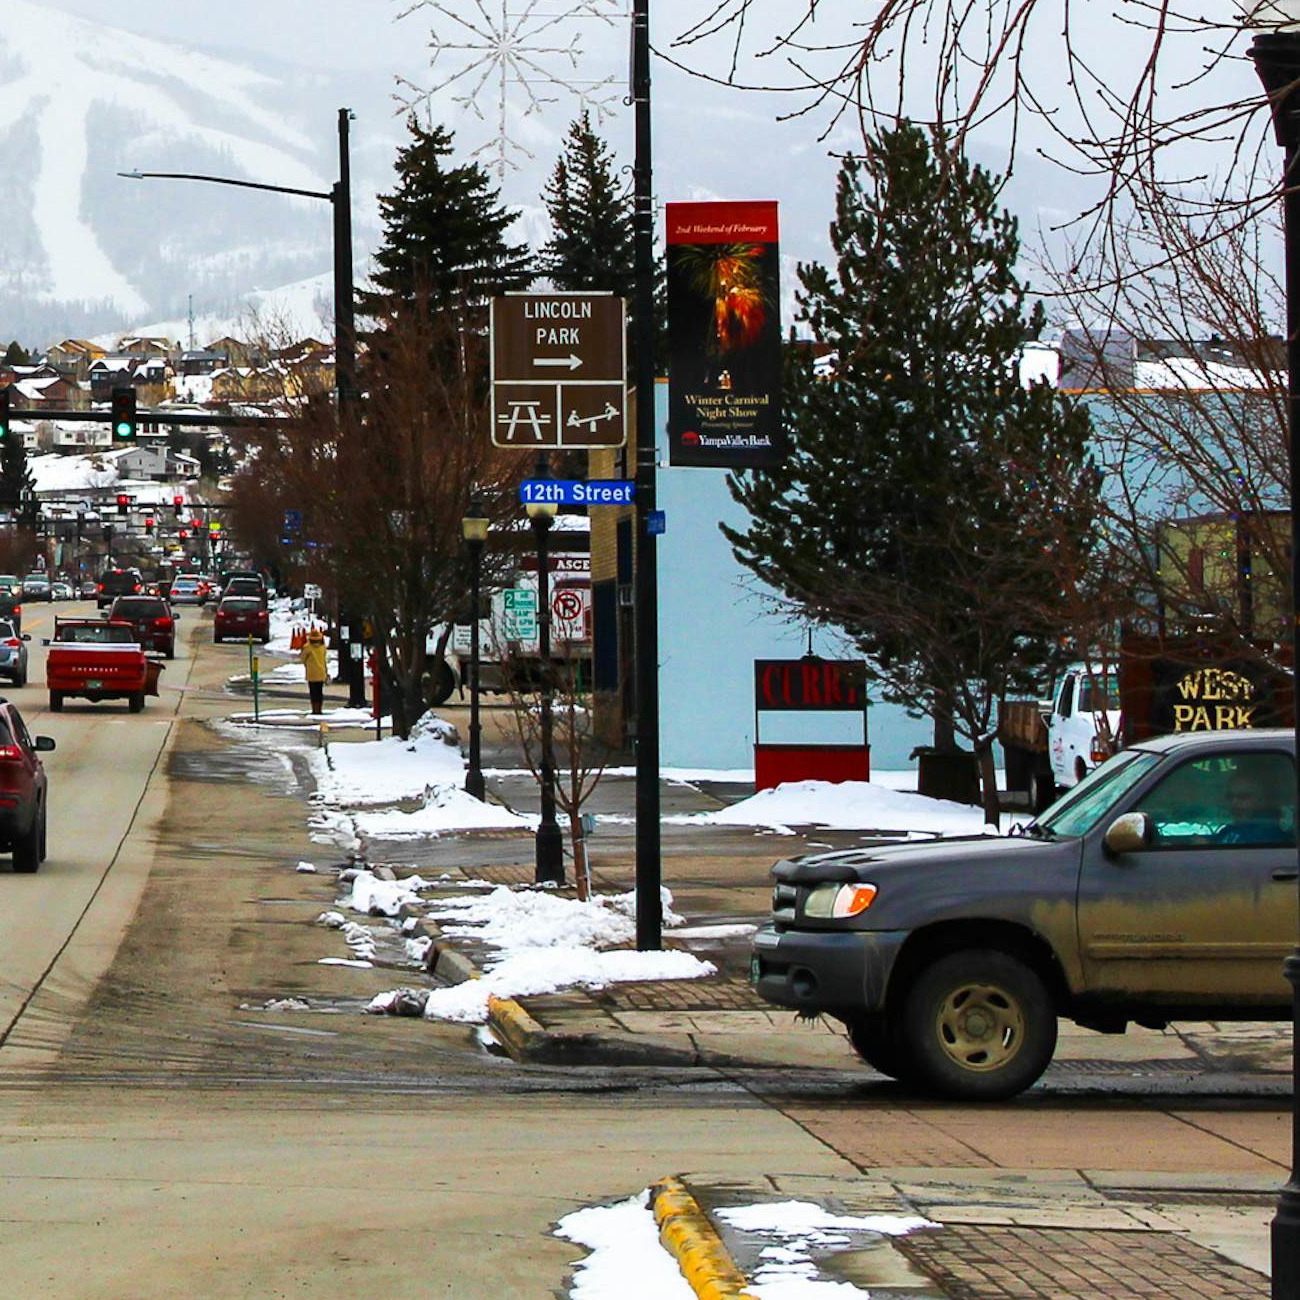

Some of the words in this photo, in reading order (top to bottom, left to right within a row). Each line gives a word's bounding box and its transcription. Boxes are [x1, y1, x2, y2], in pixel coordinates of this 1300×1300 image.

[693, 225, 725, 233] Weekend
[733, 224, 767, 234] February
[524, 301, 592, 318] LINCOLN
[536, 328, 580, 345] PARK
[685, 394, 722, 405] Winter
[725, 394, 769, 405] Carnival
[696, 407, 727, 420] Night
[729, 407, 759, 417] Show
[523, 484, 565, 501] 12th
[572, 484, 631, 501] Street
[556, 560, 590, 570] ASCE
[505, 593, 513, 608] 2
[1176, 668, 1255, 700] WEST
[1173, 704, 1256, 732] PARK
